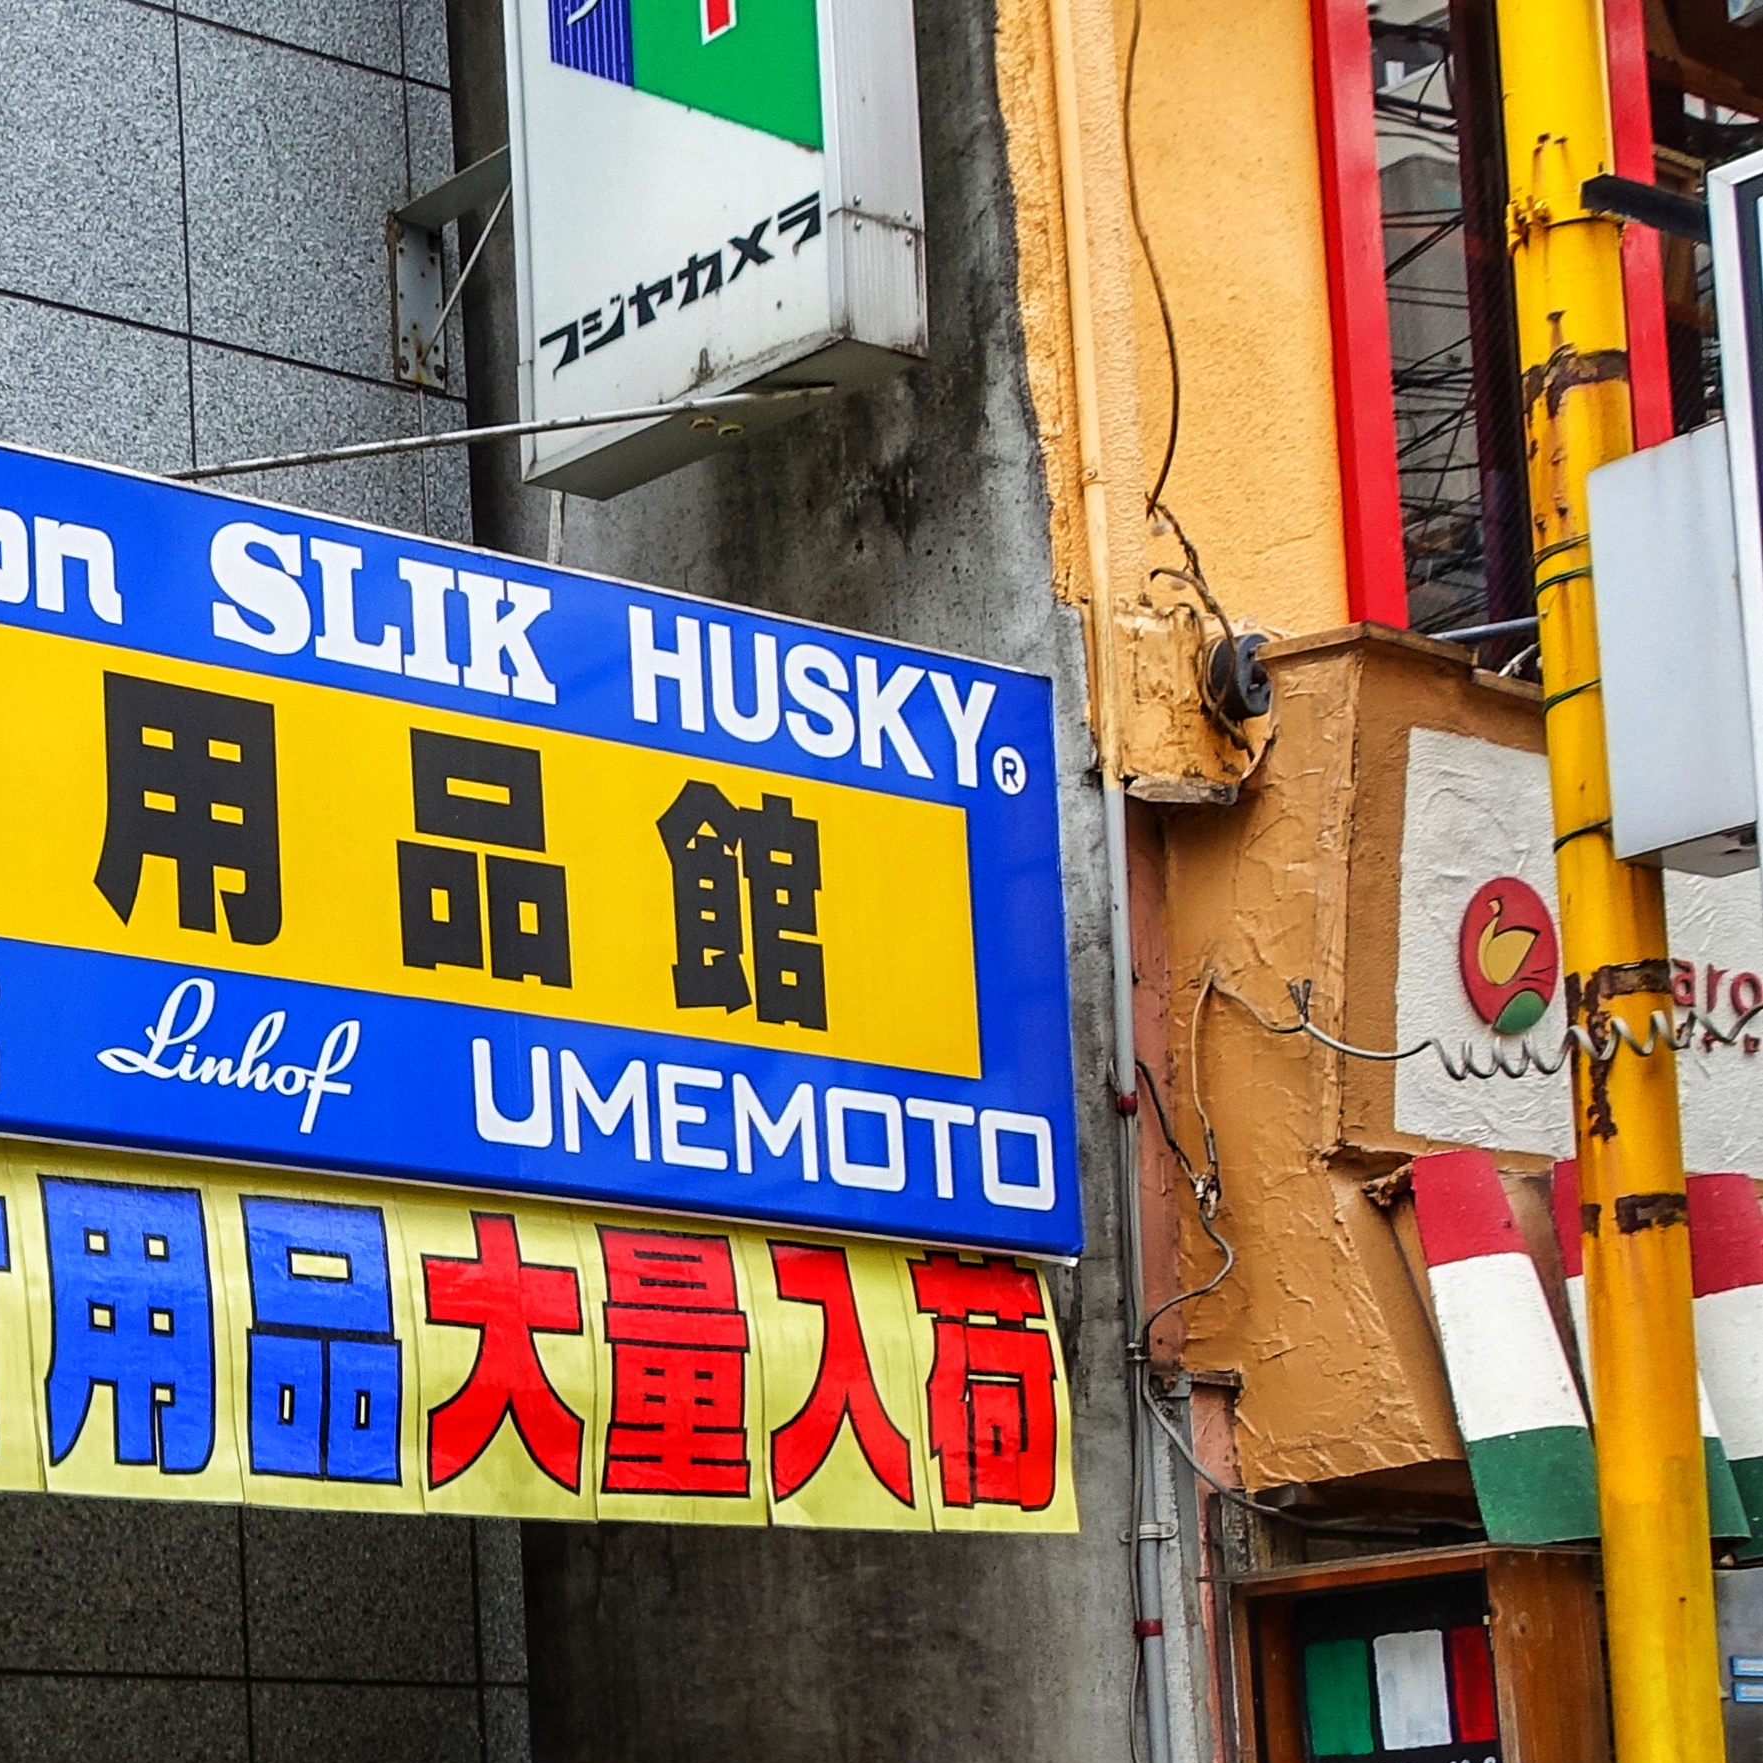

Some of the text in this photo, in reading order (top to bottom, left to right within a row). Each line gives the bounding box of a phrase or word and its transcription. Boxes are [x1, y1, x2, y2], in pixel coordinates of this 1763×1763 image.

[539, 191, 821, 379] フジヤカメラ
[210, 521, 556, 705] SLIK
[93, 671, 829, 1032] 用品館
[97, 979, 360, 1134] Linhof
[472, 1039, 1055, 1212] UMEMOTO
